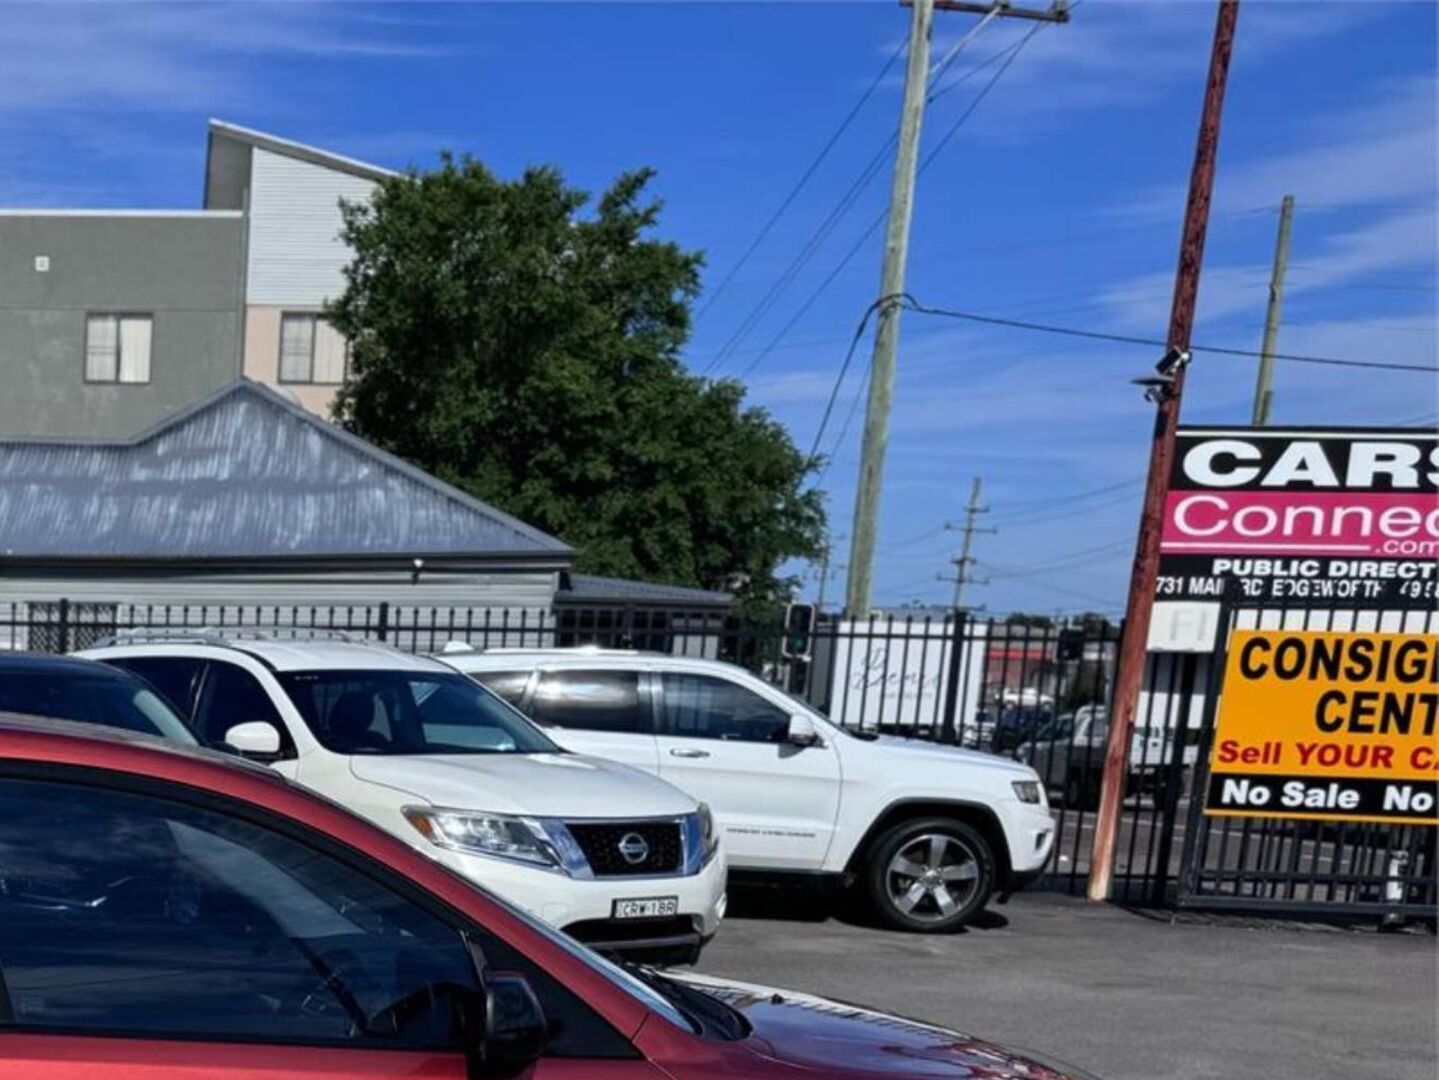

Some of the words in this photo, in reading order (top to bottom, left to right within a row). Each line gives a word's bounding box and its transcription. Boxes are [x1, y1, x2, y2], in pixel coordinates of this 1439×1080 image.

[1182, 439, 1438, 488] CAR
[1173, 494, 1438, 538] Conne
[1212, 558, 1321, 578] PUBLIC
[1328, 560, 1437, 579] DIRECT
[1155, 576, 1184, 594] 731
[1188, 576, 1225, 596] MAI
[1218, 739, 1283, 766] Sell
[1295, 742, 1395, 769] YOUR
[1410, 746, 1438, 771] C
[1221, 778, 1271, 806] No
[1281, 781, 1360, 809] Sale
[1383, 785, 1433, 812] No
